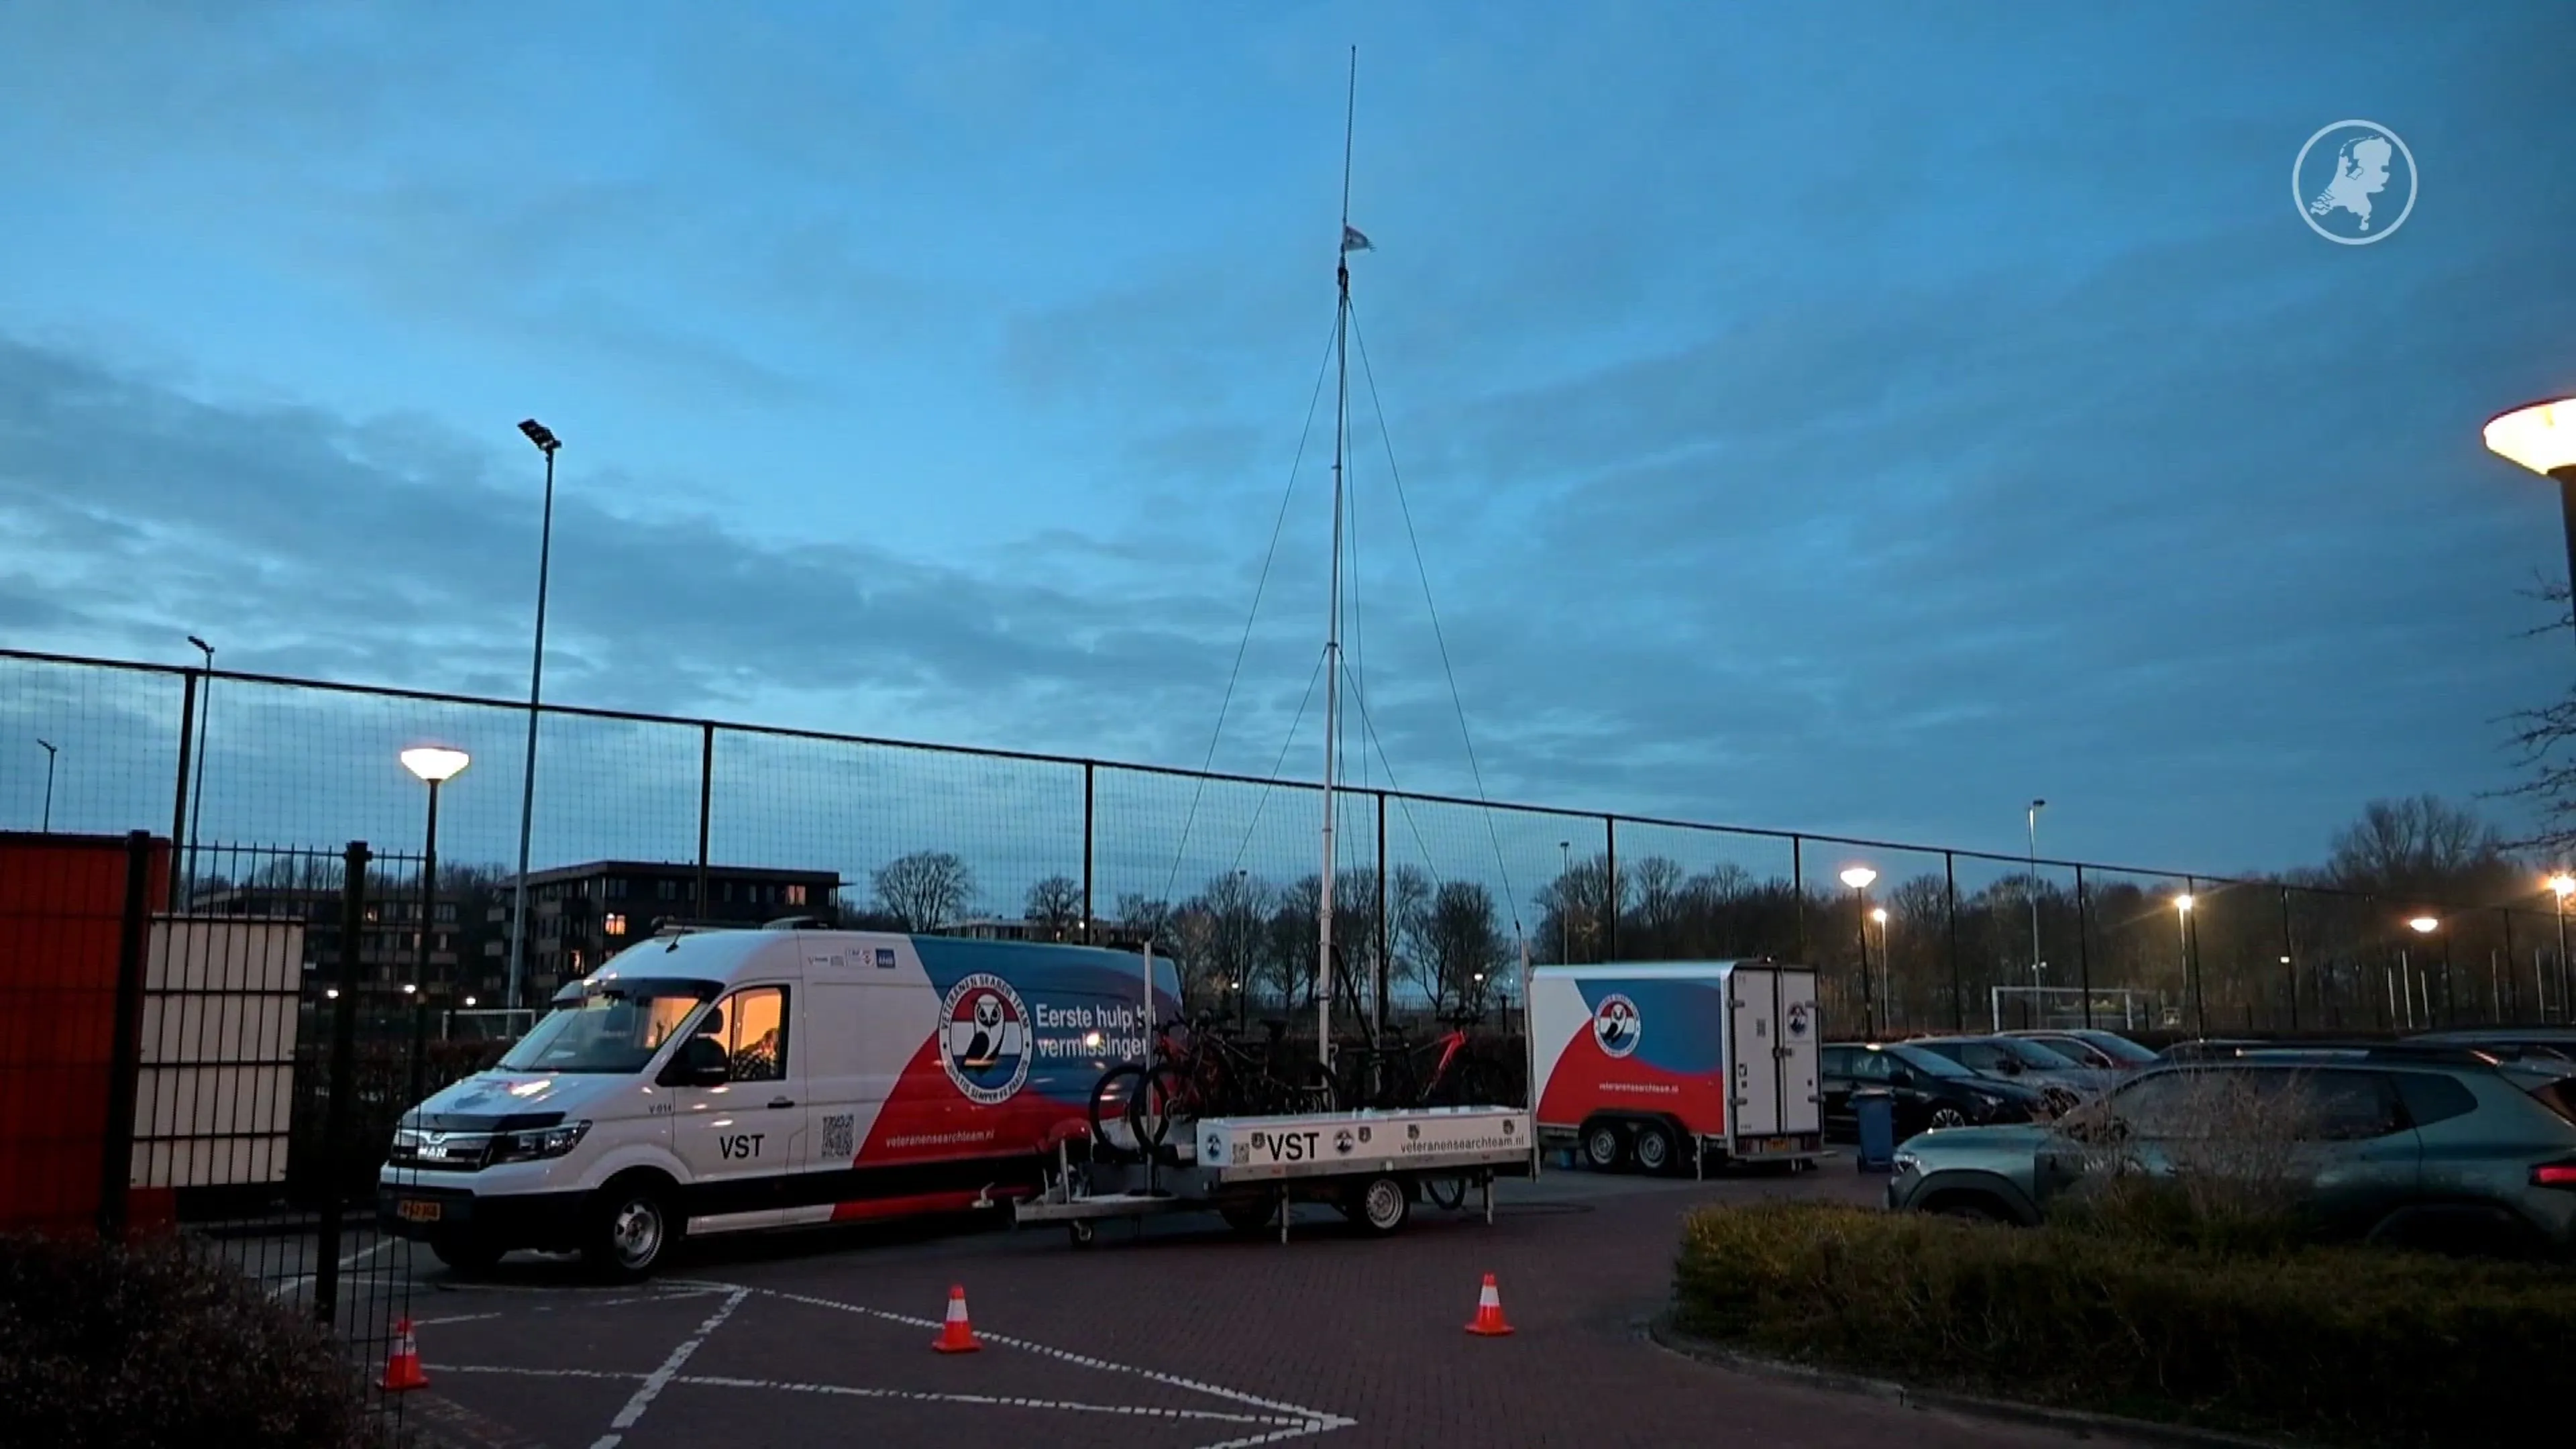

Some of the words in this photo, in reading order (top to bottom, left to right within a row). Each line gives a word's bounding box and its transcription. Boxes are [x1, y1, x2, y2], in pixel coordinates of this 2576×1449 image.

[941, 976, 977, 1029] VETERANEN
[979, 975, 1012, 999] SEARCH
[1012, 995, 1030, 1029] TEAM
[1035, 1003, 1093, 1028] Eerste
[1095, 1003, 1134, 1034] hulp
[719, 1134, 765, 1159] VST
[885, 1128, 996, 1148] veteranensearchteam.nl
[1267, 1132, 1320, 1161] VST
[1400, 1134, 1525, 1153] veteranensearchteam.nl
[417, 1145, 448, 1160] MAN
